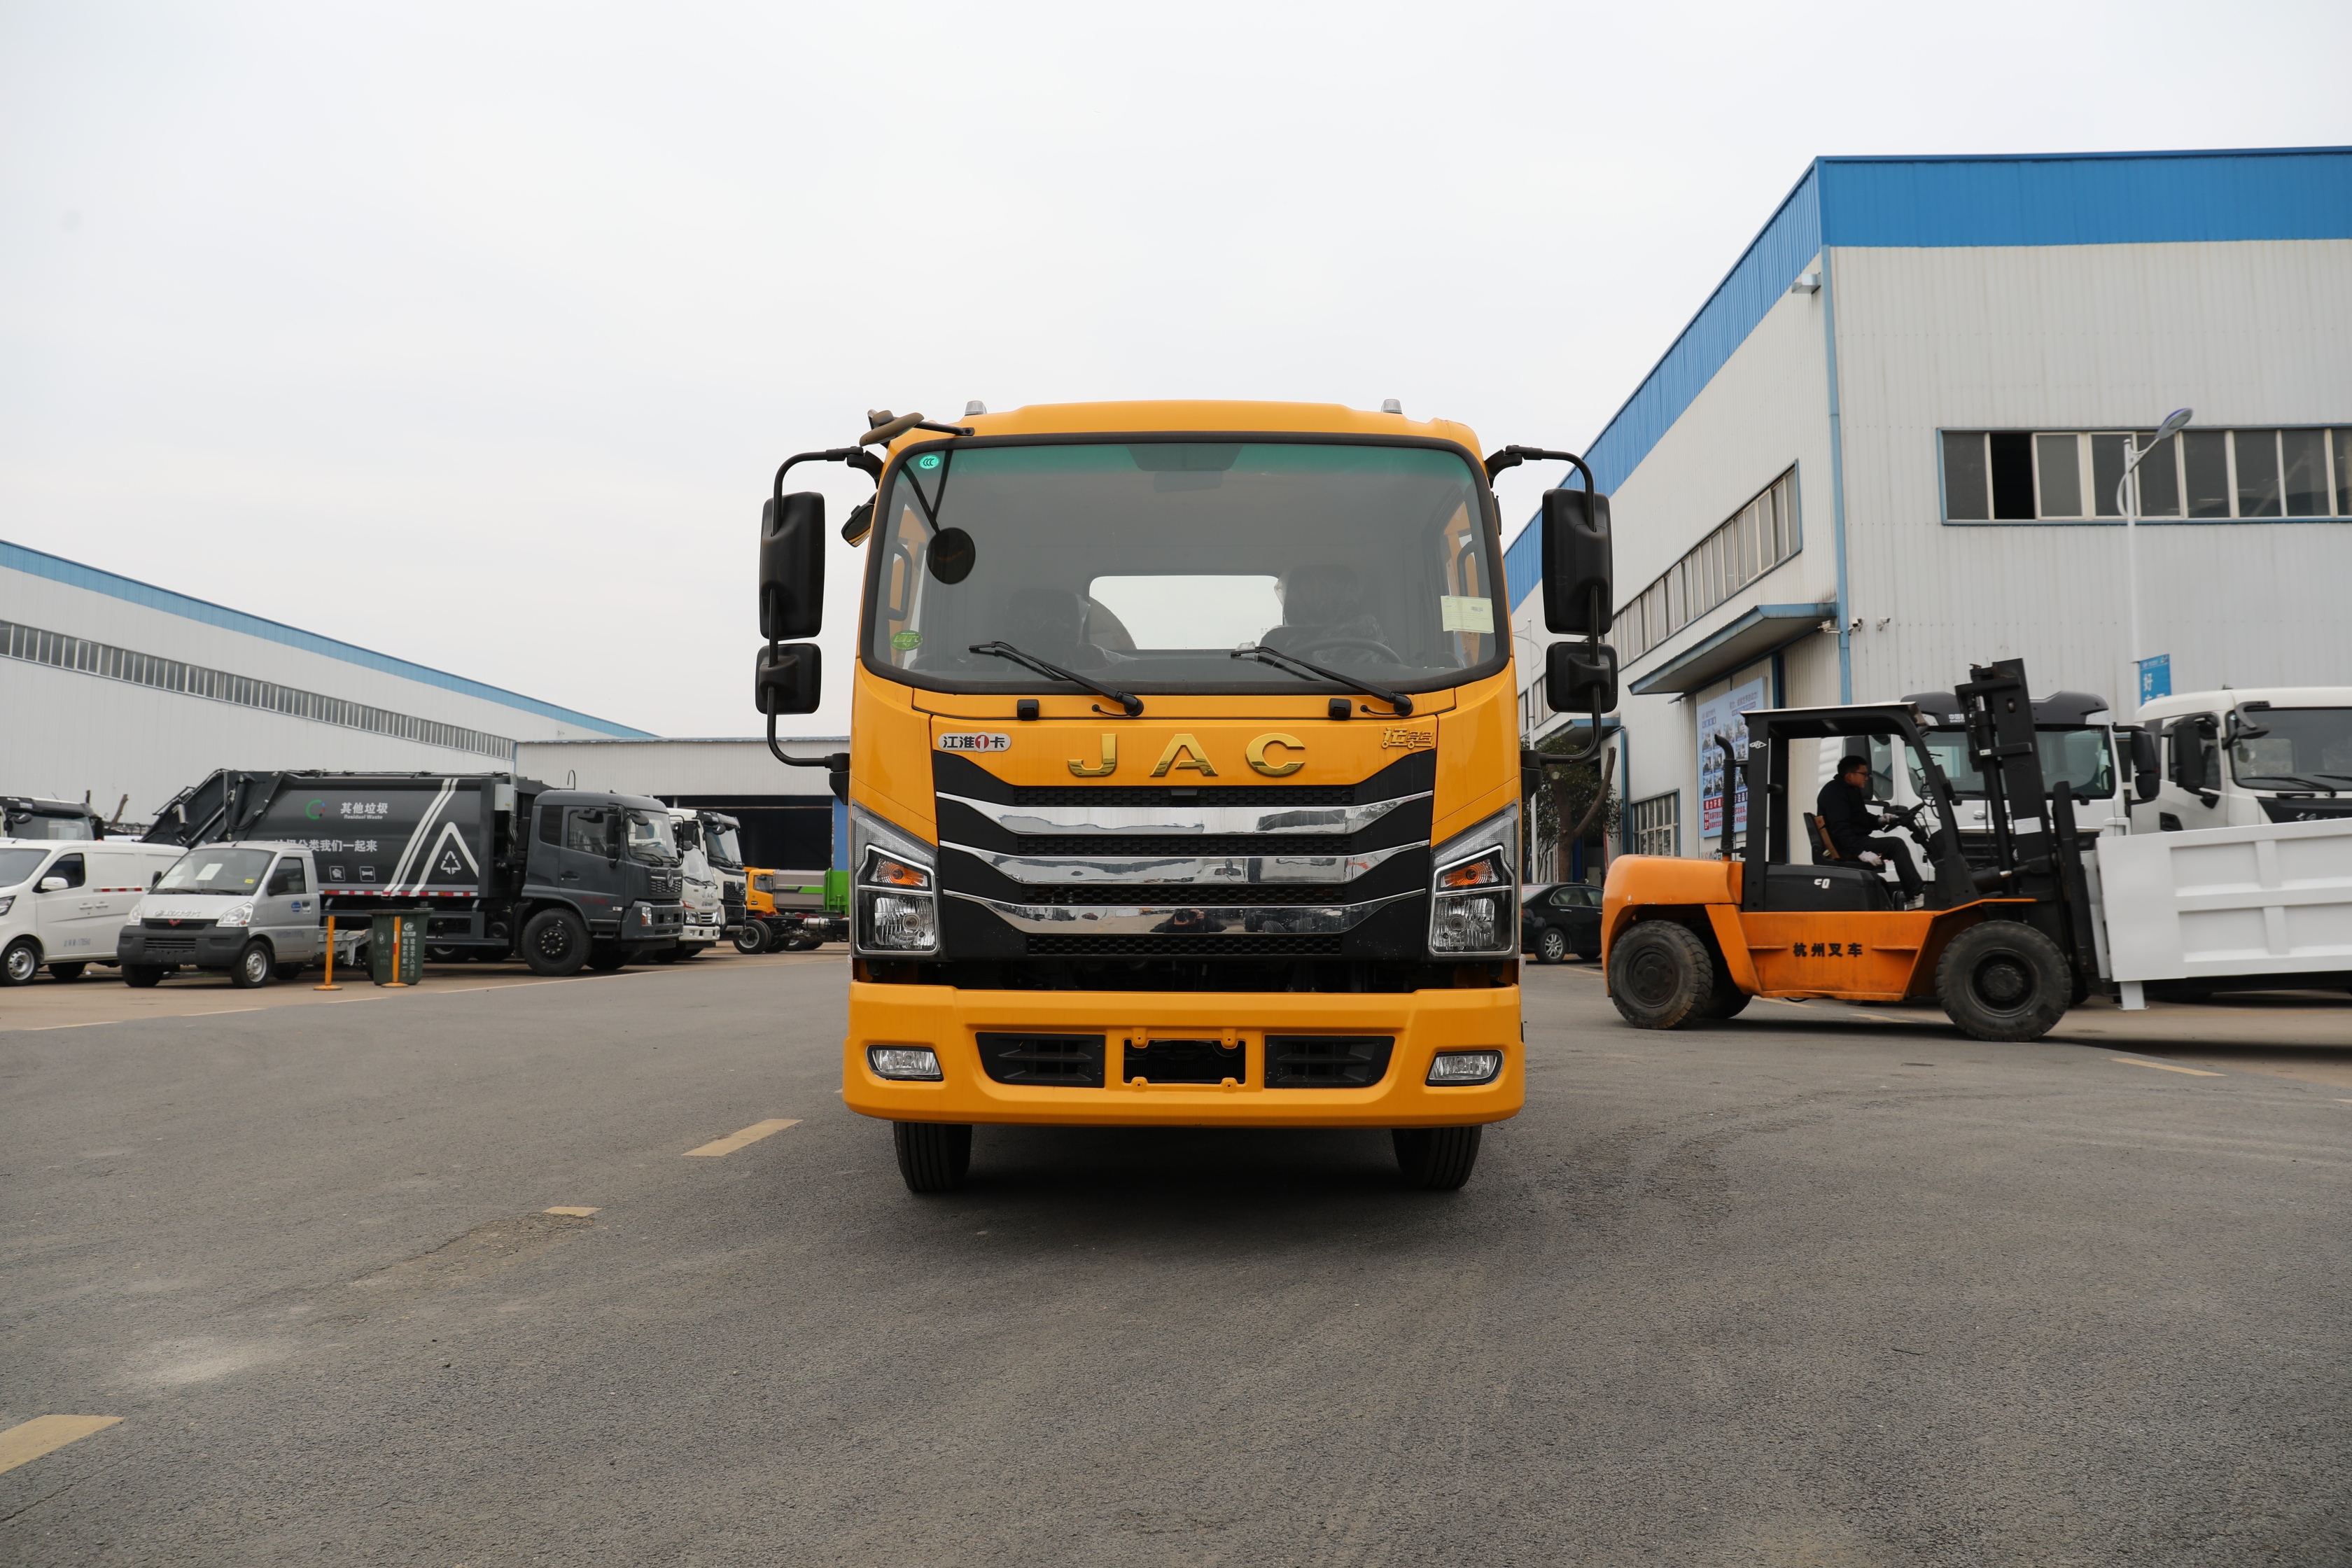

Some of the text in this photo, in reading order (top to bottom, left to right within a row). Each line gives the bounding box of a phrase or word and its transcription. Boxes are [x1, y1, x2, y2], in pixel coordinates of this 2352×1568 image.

[1068, 733, 1306, 778] JAC
[340, 802, 388, 813] 其他垃圾
[275, 839, 377, 852] 分类我们一起来
[1793, 942, 1863, 958] 杭州叉车
